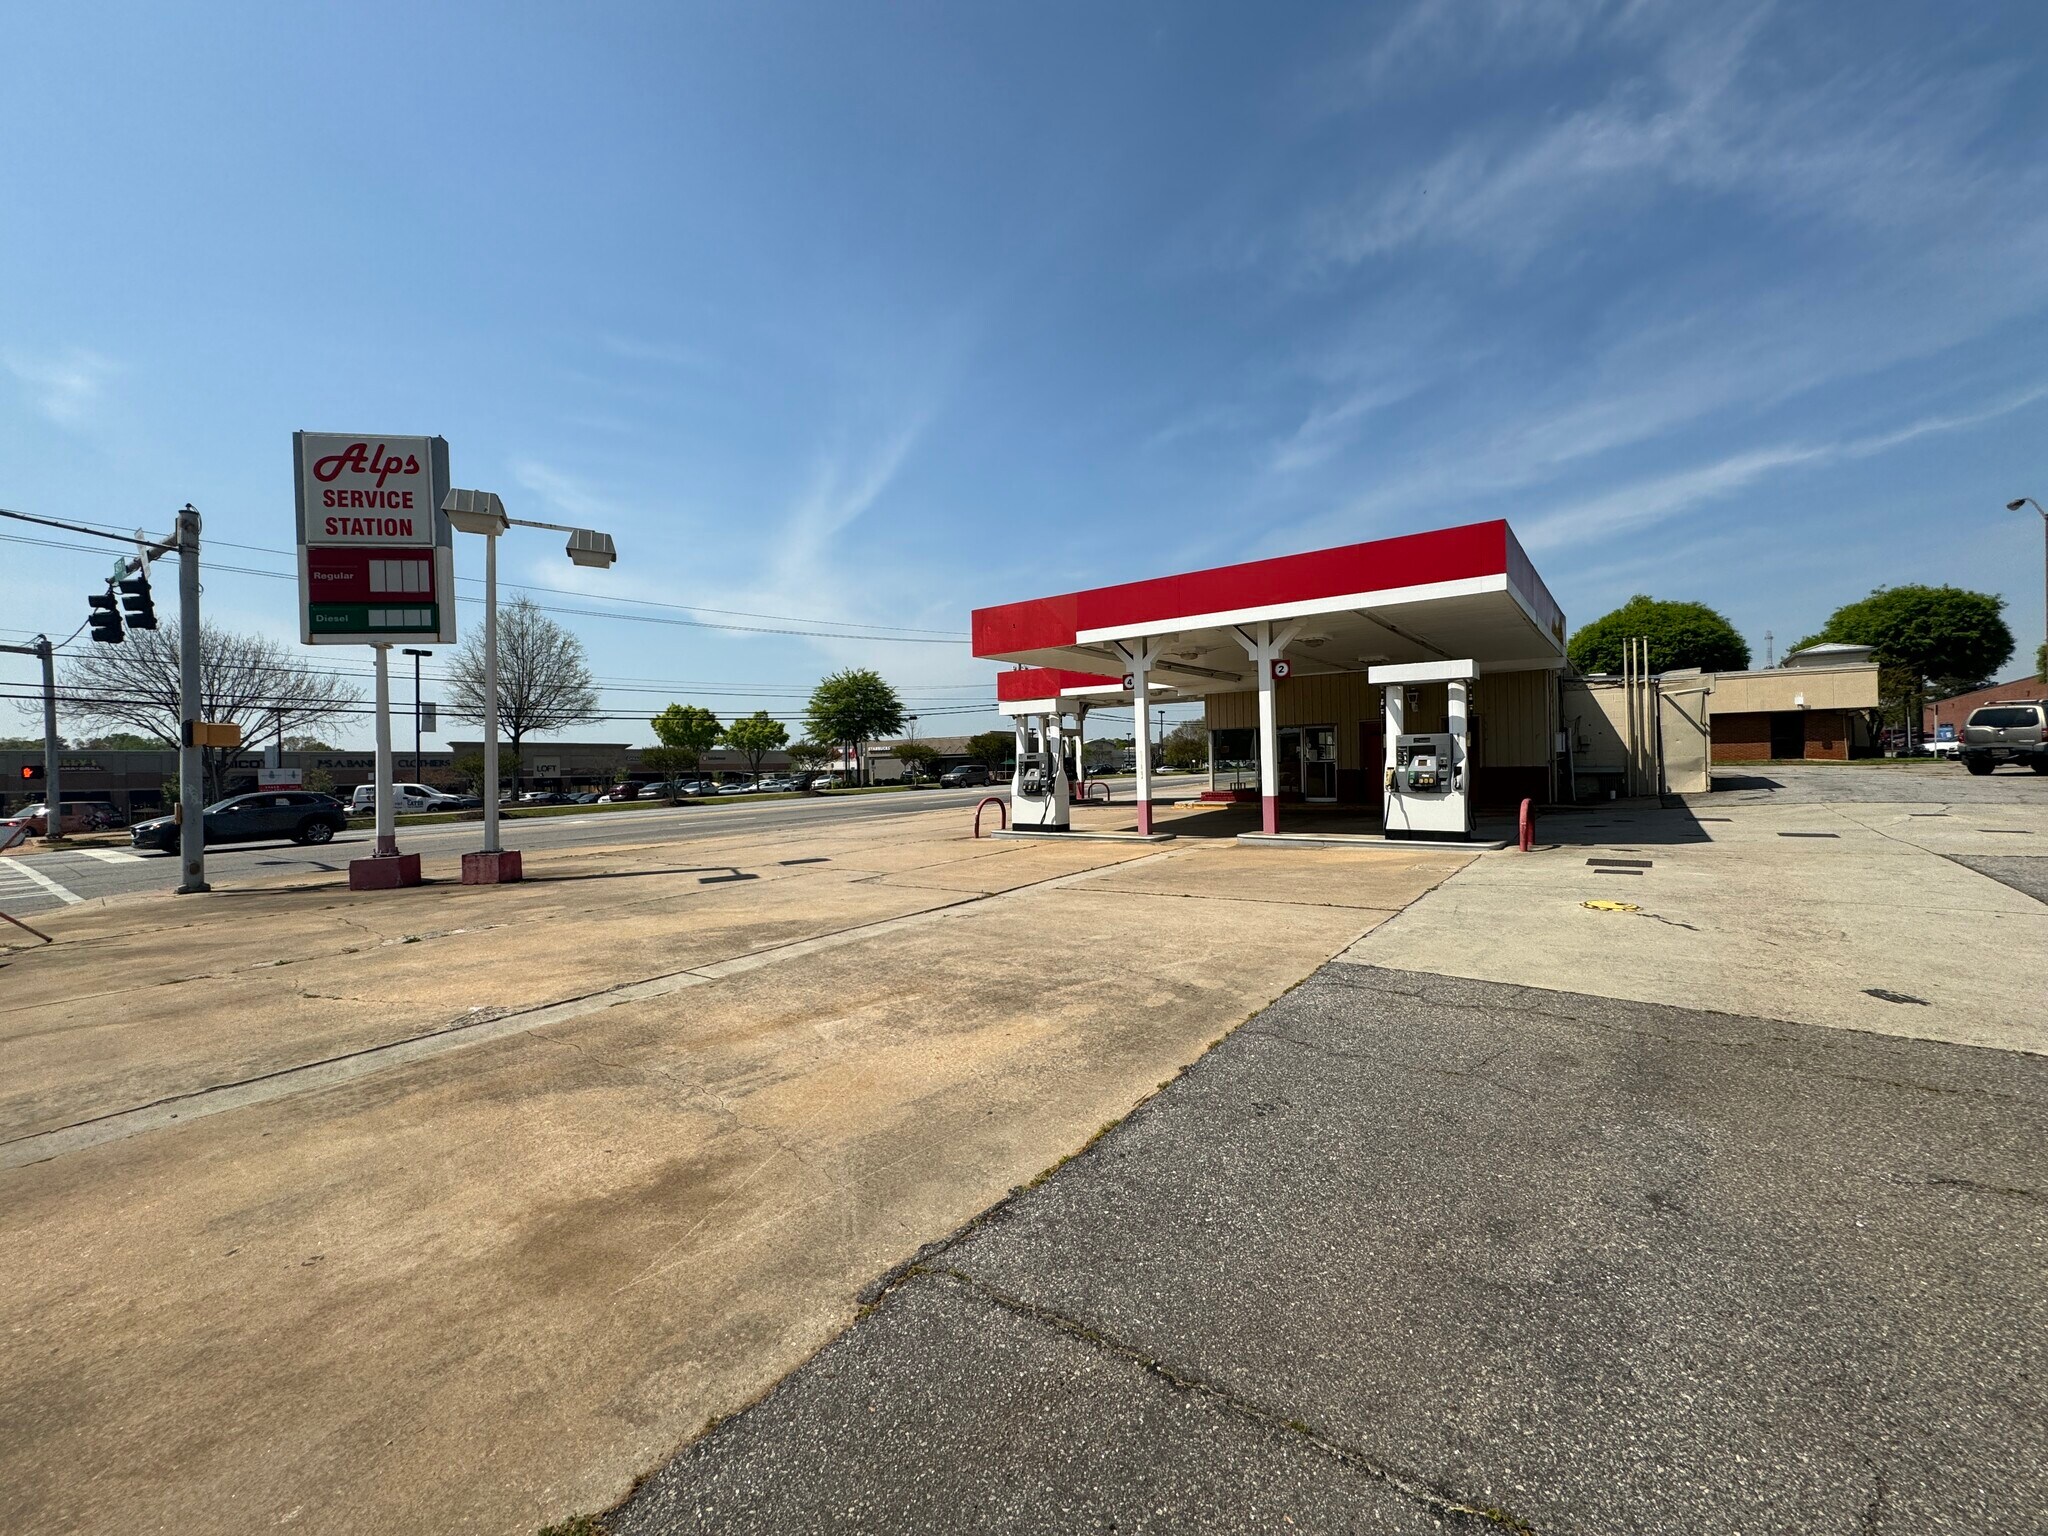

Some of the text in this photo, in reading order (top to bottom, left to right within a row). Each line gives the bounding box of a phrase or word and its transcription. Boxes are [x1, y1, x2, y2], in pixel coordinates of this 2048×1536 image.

[313, 443, 420, 488] Alps
[323, 489, 414, 509] SERVICE
[325, 517, 413, 536] STATION
[313, 571, 354, 581] Regular
[315, 614, 349, 622] Diesel
[1278, 665, 1285, 674] 2
[1126, 678, 1133, 686] 4
[536, 765, 557, 773] LOFT
